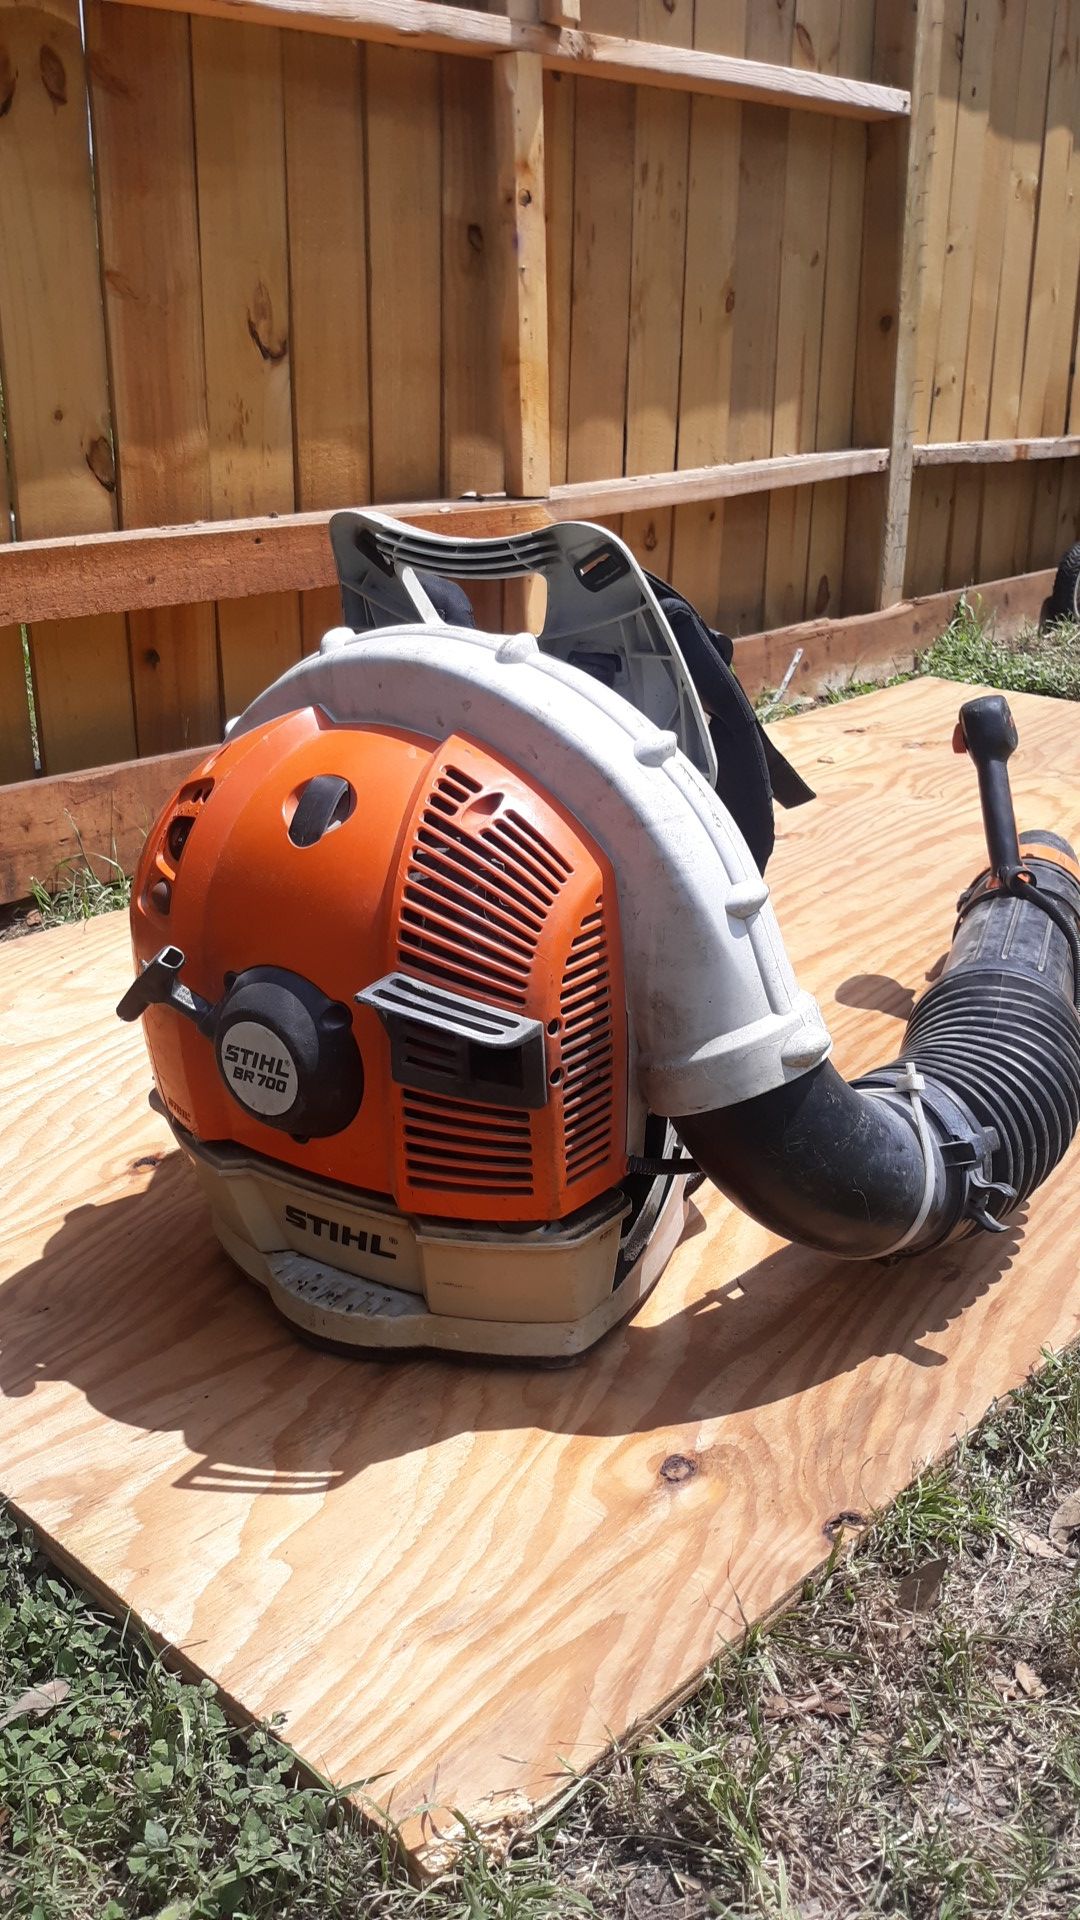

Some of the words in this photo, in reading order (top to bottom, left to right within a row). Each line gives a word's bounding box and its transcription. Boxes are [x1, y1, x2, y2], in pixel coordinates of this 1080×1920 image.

[224, 1044, 290, 1078] STIHL
[233, 1066, 255, 1083] BR
[257, 1073, 287, 1093] 700
[285, 1204, 397, 1260] STIHL
